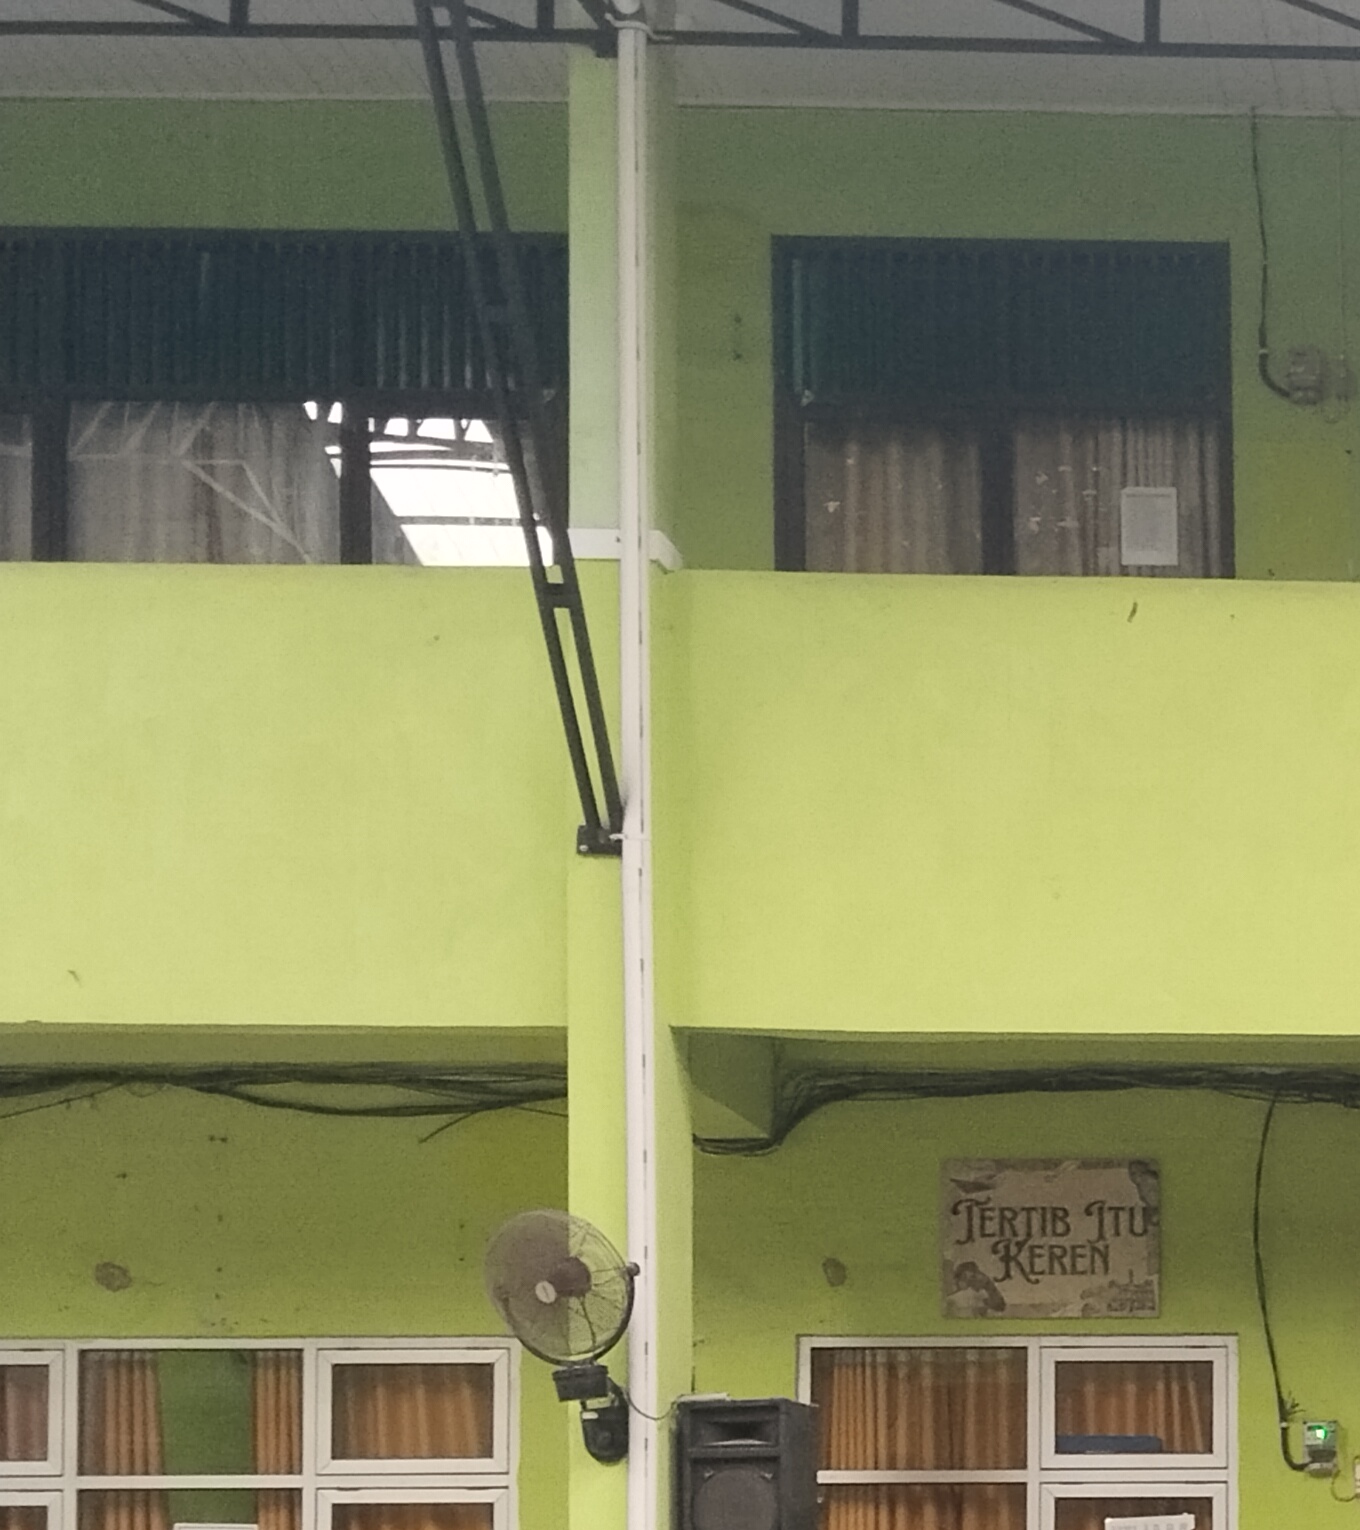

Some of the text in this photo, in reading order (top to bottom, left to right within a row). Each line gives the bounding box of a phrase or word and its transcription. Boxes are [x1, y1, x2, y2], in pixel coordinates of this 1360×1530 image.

[951, 1197, 1149, 1246] TERTIB ITU
[991, 1238, 1111, 1285] KEREN
